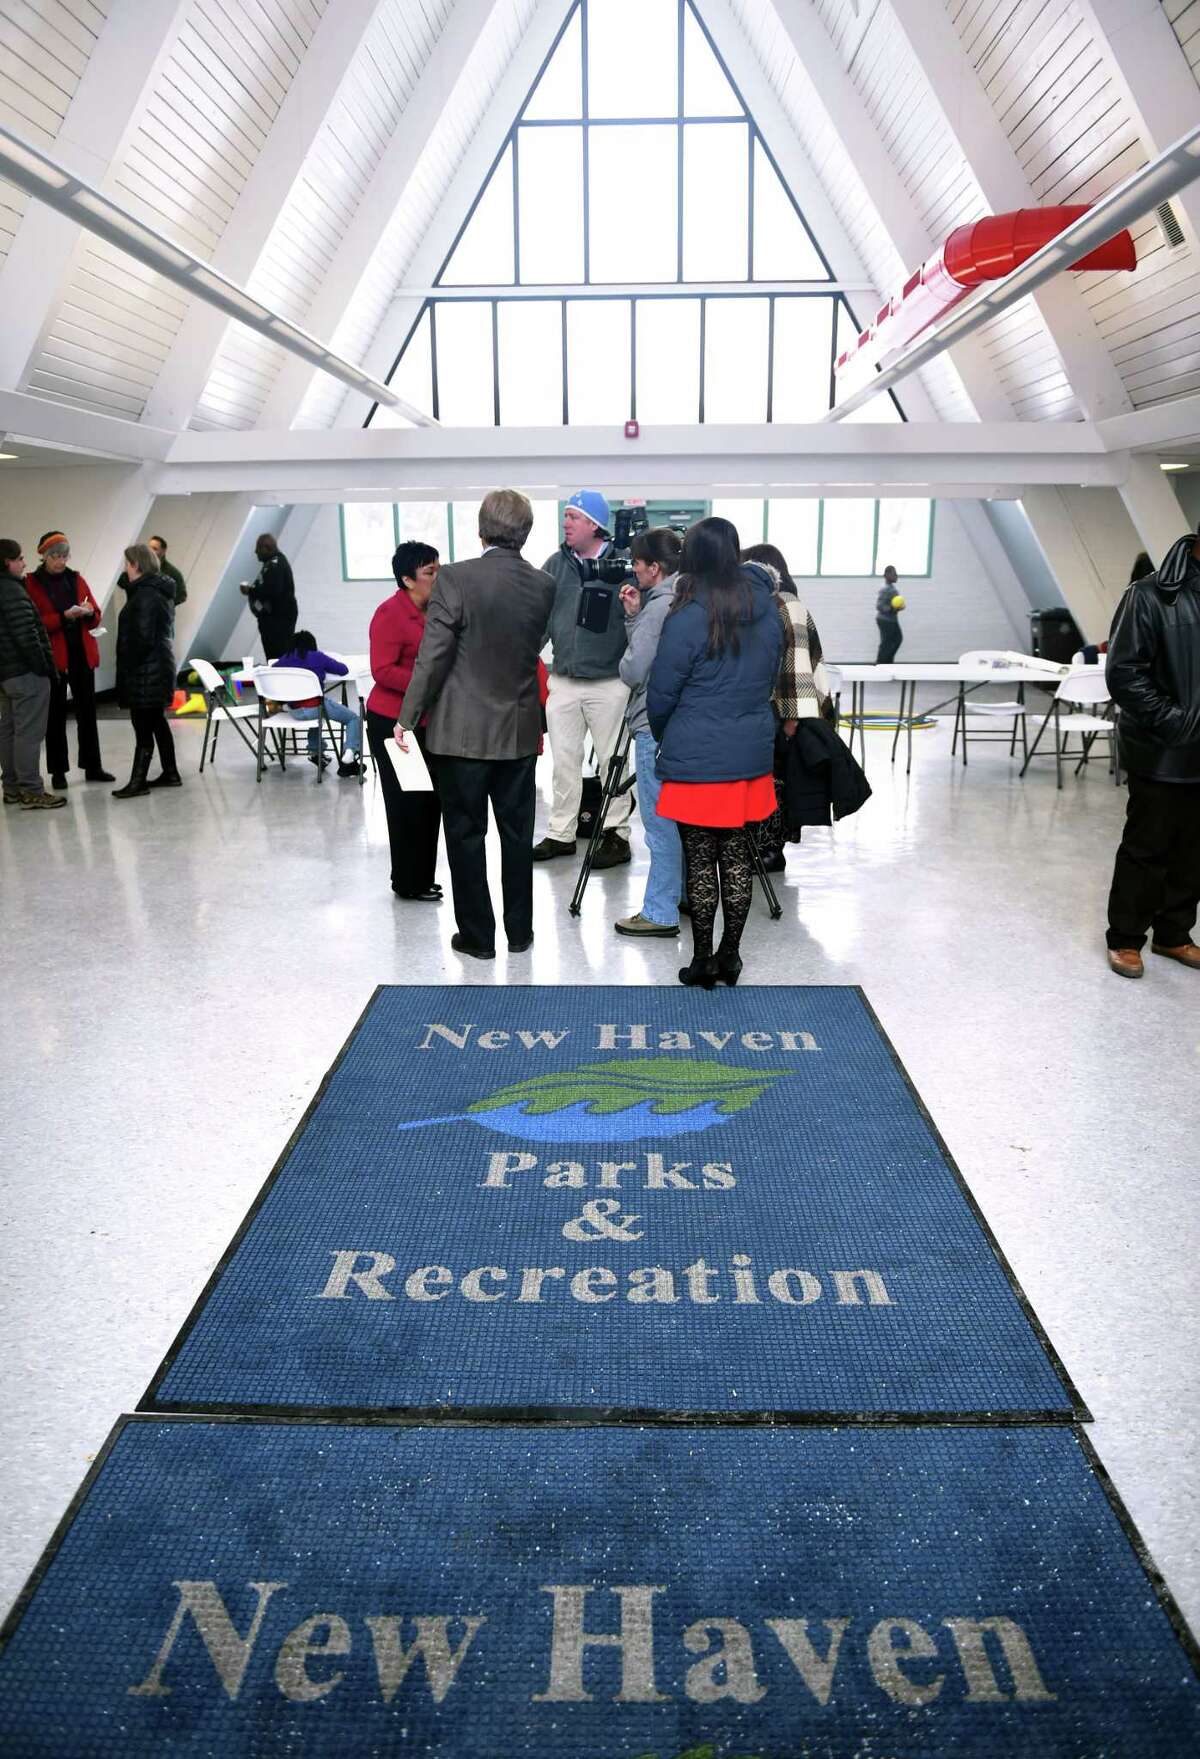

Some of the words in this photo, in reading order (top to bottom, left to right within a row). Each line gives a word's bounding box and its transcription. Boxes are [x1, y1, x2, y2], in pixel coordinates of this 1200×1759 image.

[416, 1023, 570, 1051] New
[592, 1023, 822, 1052] Haven
[476, 1152, 737, 1190] Parks
[562, 1198, 645, 1242] &
[317, 1250, 898, 1305] Recreation
[127, 1580, 488, 1703] New
[531, 1584, 1058, 1706] Haven
